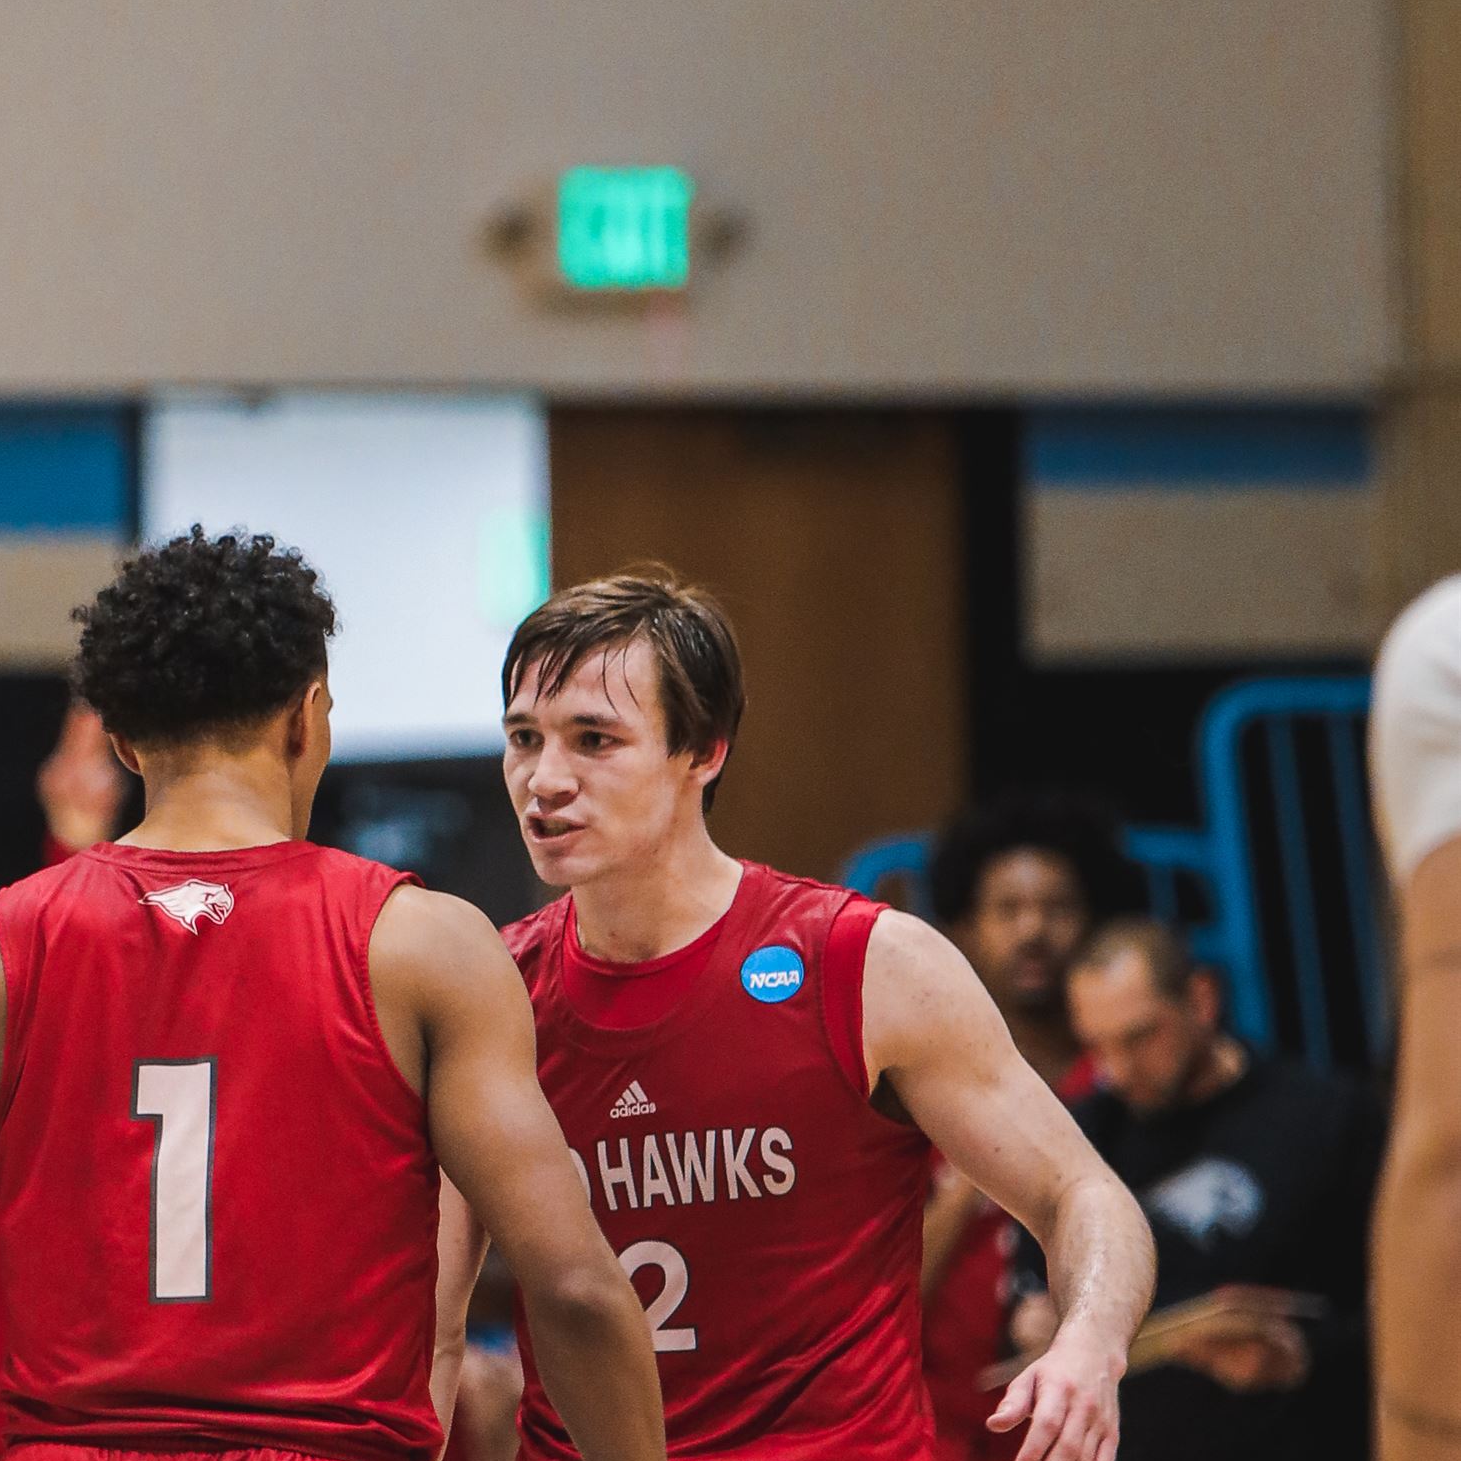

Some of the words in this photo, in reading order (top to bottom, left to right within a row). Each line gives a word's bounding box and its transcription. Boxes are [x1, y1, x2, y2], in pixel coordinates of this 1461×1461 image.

[749, 970, 800, 989] NCAA
[610, 1102, 656, 1118] adidas
[131, 1055, 218, 1303] 1
[569, 1127, 796, 1211] HAWKS
[617, 1240, 696, 1352] 2
